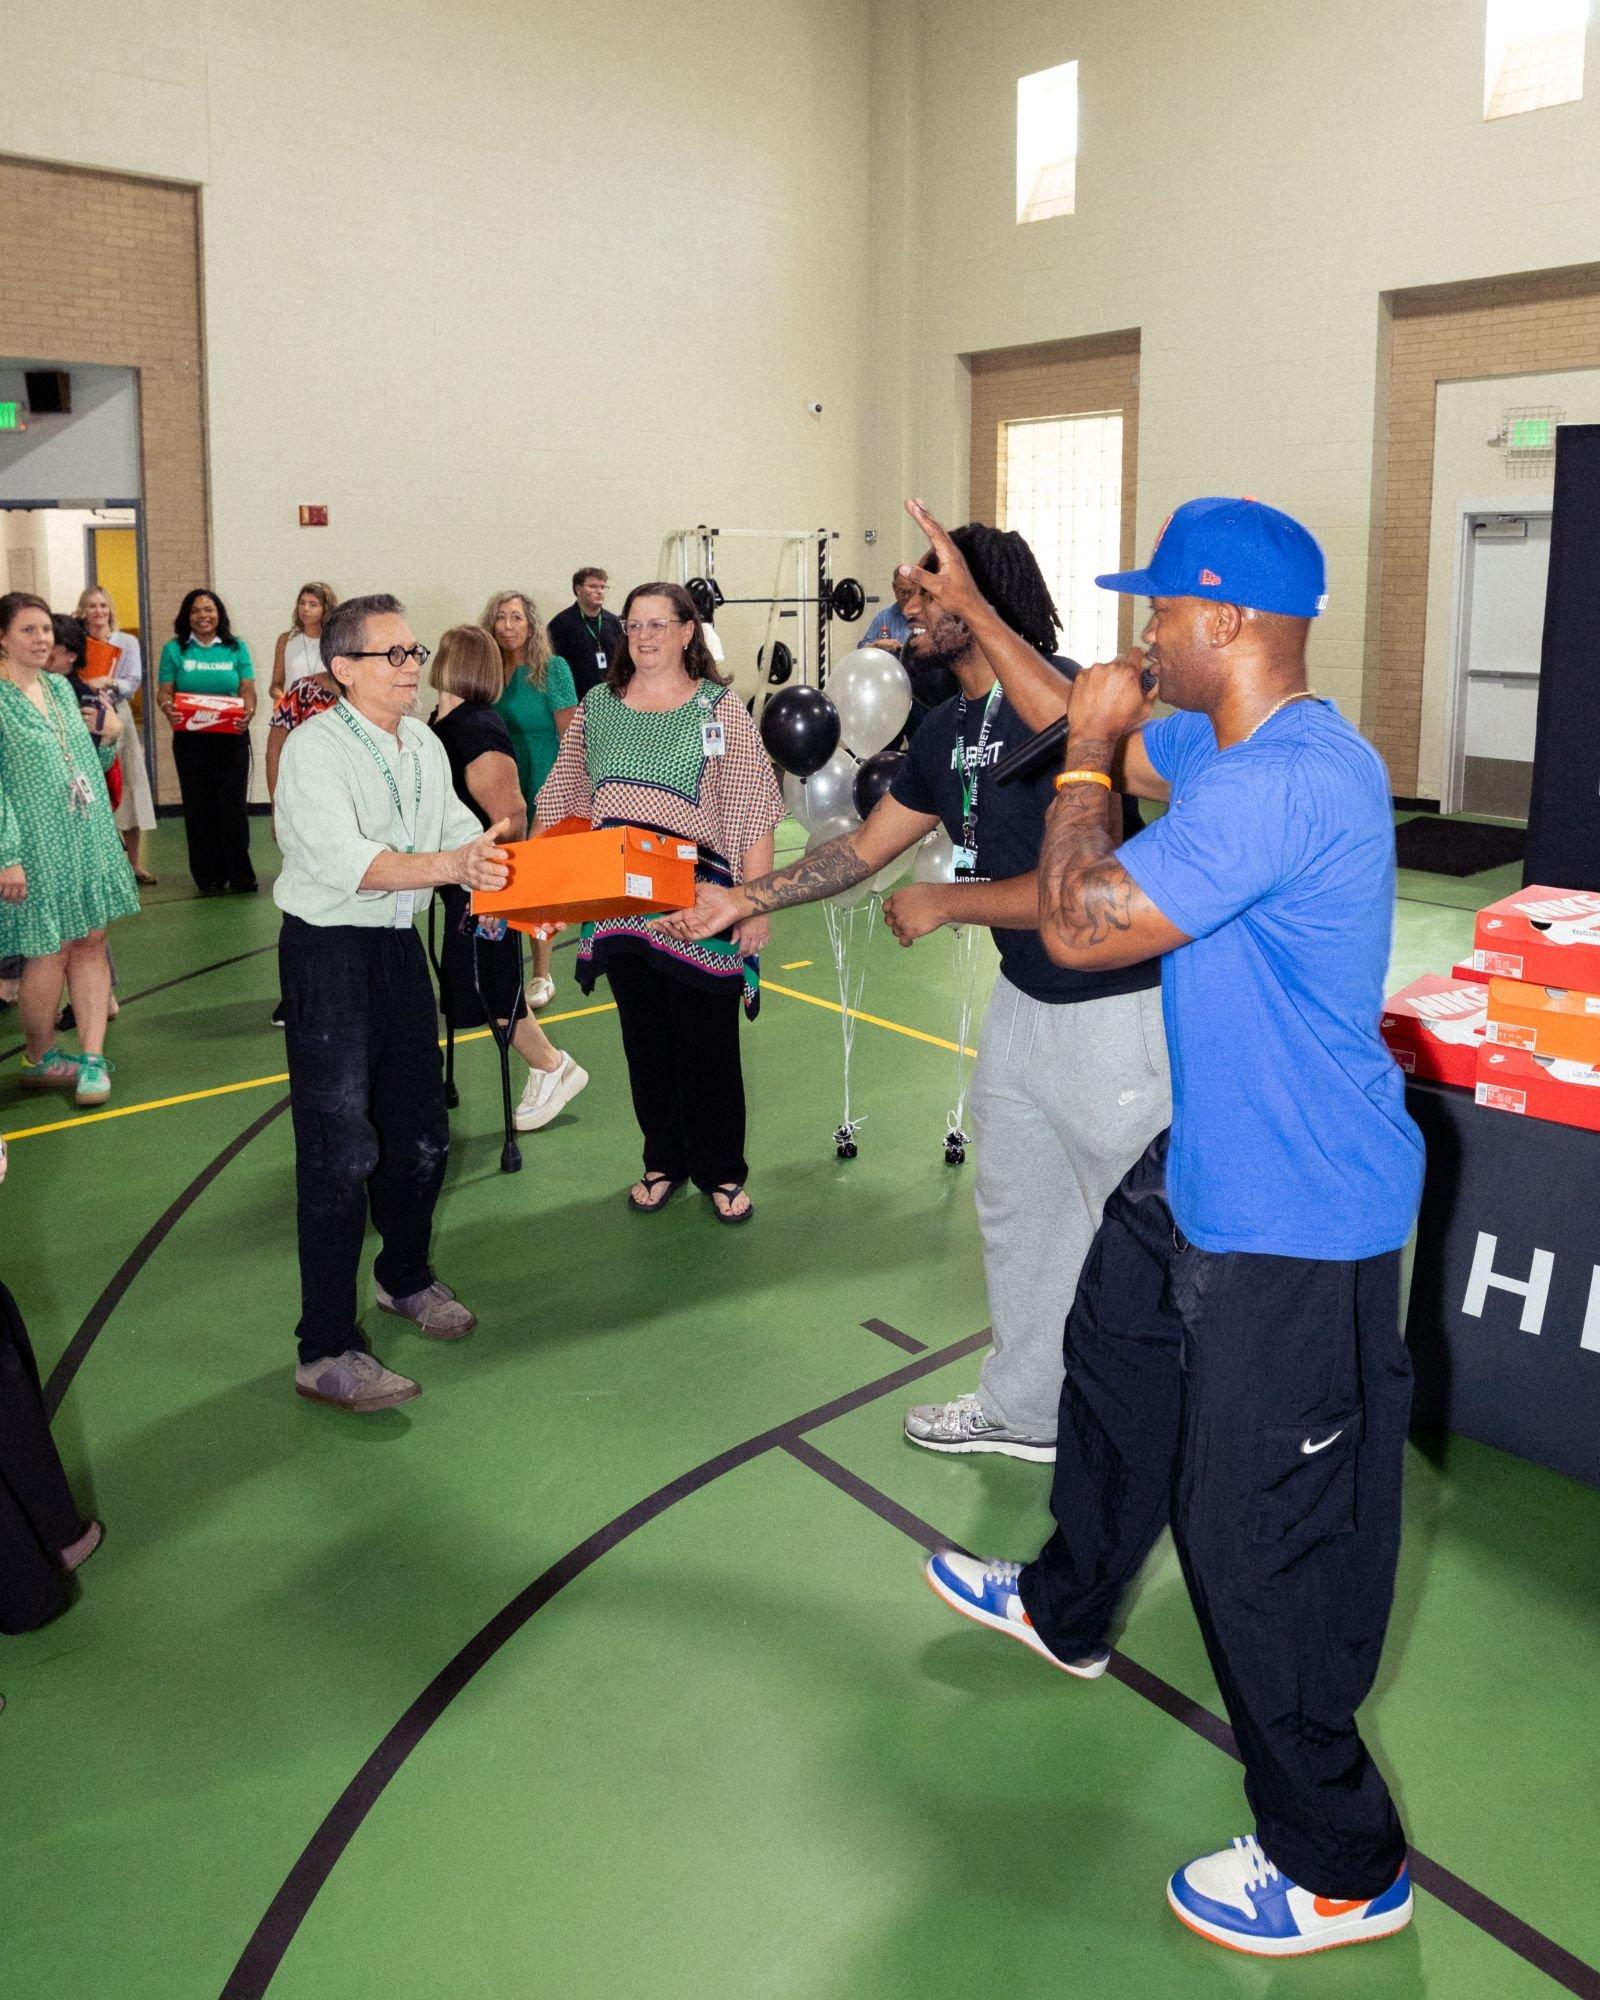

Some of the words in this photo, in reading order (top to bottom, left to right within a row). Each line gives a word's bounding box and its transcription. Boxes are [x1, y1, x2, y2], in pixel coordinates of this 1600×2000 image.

[193, 711, 221, 722] NIKE
[348, 719, 388, 773] STRENGTHS
[957, 735, 971, 777] HIBBETT
[978, 720, 993, 764] HIBBETT
